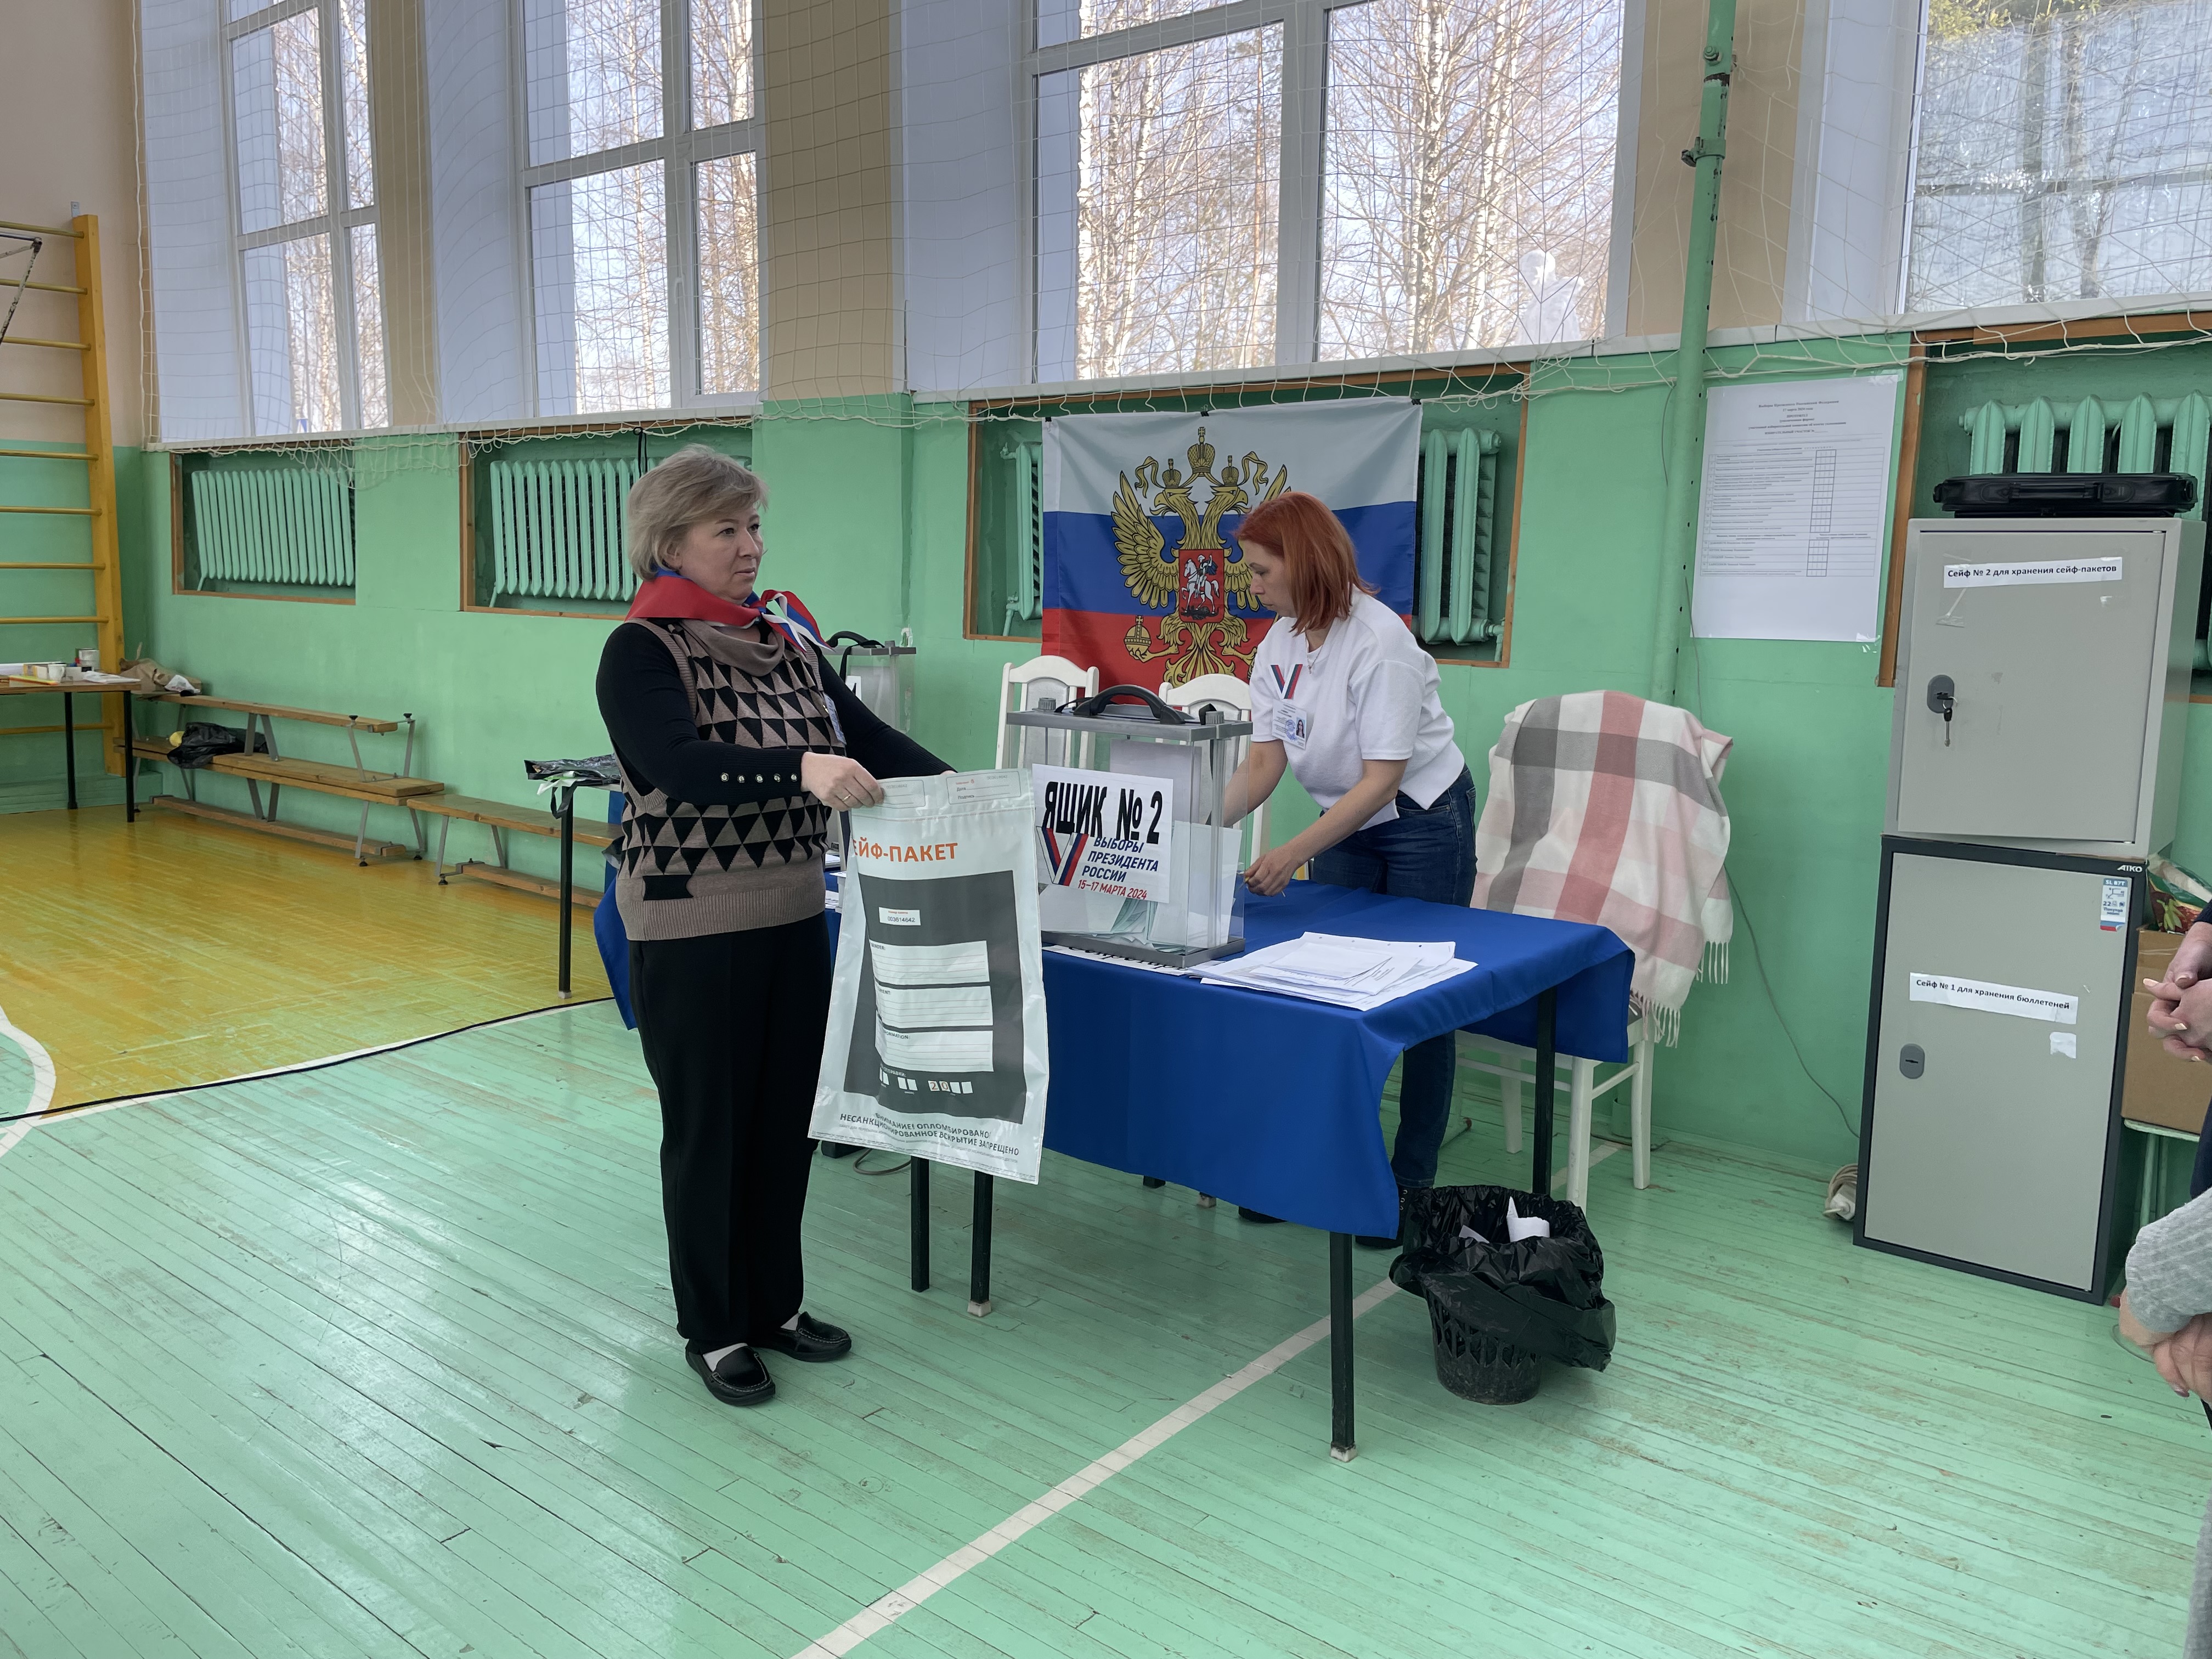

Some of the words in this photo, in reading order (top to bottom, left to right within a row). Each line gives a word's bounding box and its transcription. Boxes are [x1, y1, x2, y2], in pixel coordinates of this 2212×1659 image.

[1948, 569, 1971, 578] Сейф
[2011, 567, 2054, 577] хранения
[2056, 565, 2117, 574] сейф-пакетов
[1042, 781, 1108, 839] ЯЩИК
[1116, 788, 1143, 842] №
[1146, 791, 1163, 845] 2
[1093, 837, 1144, 854] ВЫБОРЫ
[1087, 850, 1159, 872] ПРЕЗИДЕНТА
[2117, 865, 2143, 873] AIKO
[1081, 865, 1127, 883] РОССИИ
[1099, 883, 1126, 896] МАРТА
[1126, 888, 1147, 900] 2024
[1916, 979, 1937, 989] Сейф
[1974, 989, 2015, 1001] хранения
[2016, 995, 2070, 1009] бюллетеней
[840, 1113, 938, 1137] НЕСАНКЦИОНИРОВАННОЕ
[939, 1131, 978, 1147] ВСКРЫТИЕ
[979, 1141, 1019, 1156] ЗАПРЕЩЕНО
[875, 1113, 915, 1130] ВНИМАНИЕ!
[917, 1123, 991, 1139] ОПЛОМБИРОВАНО!
